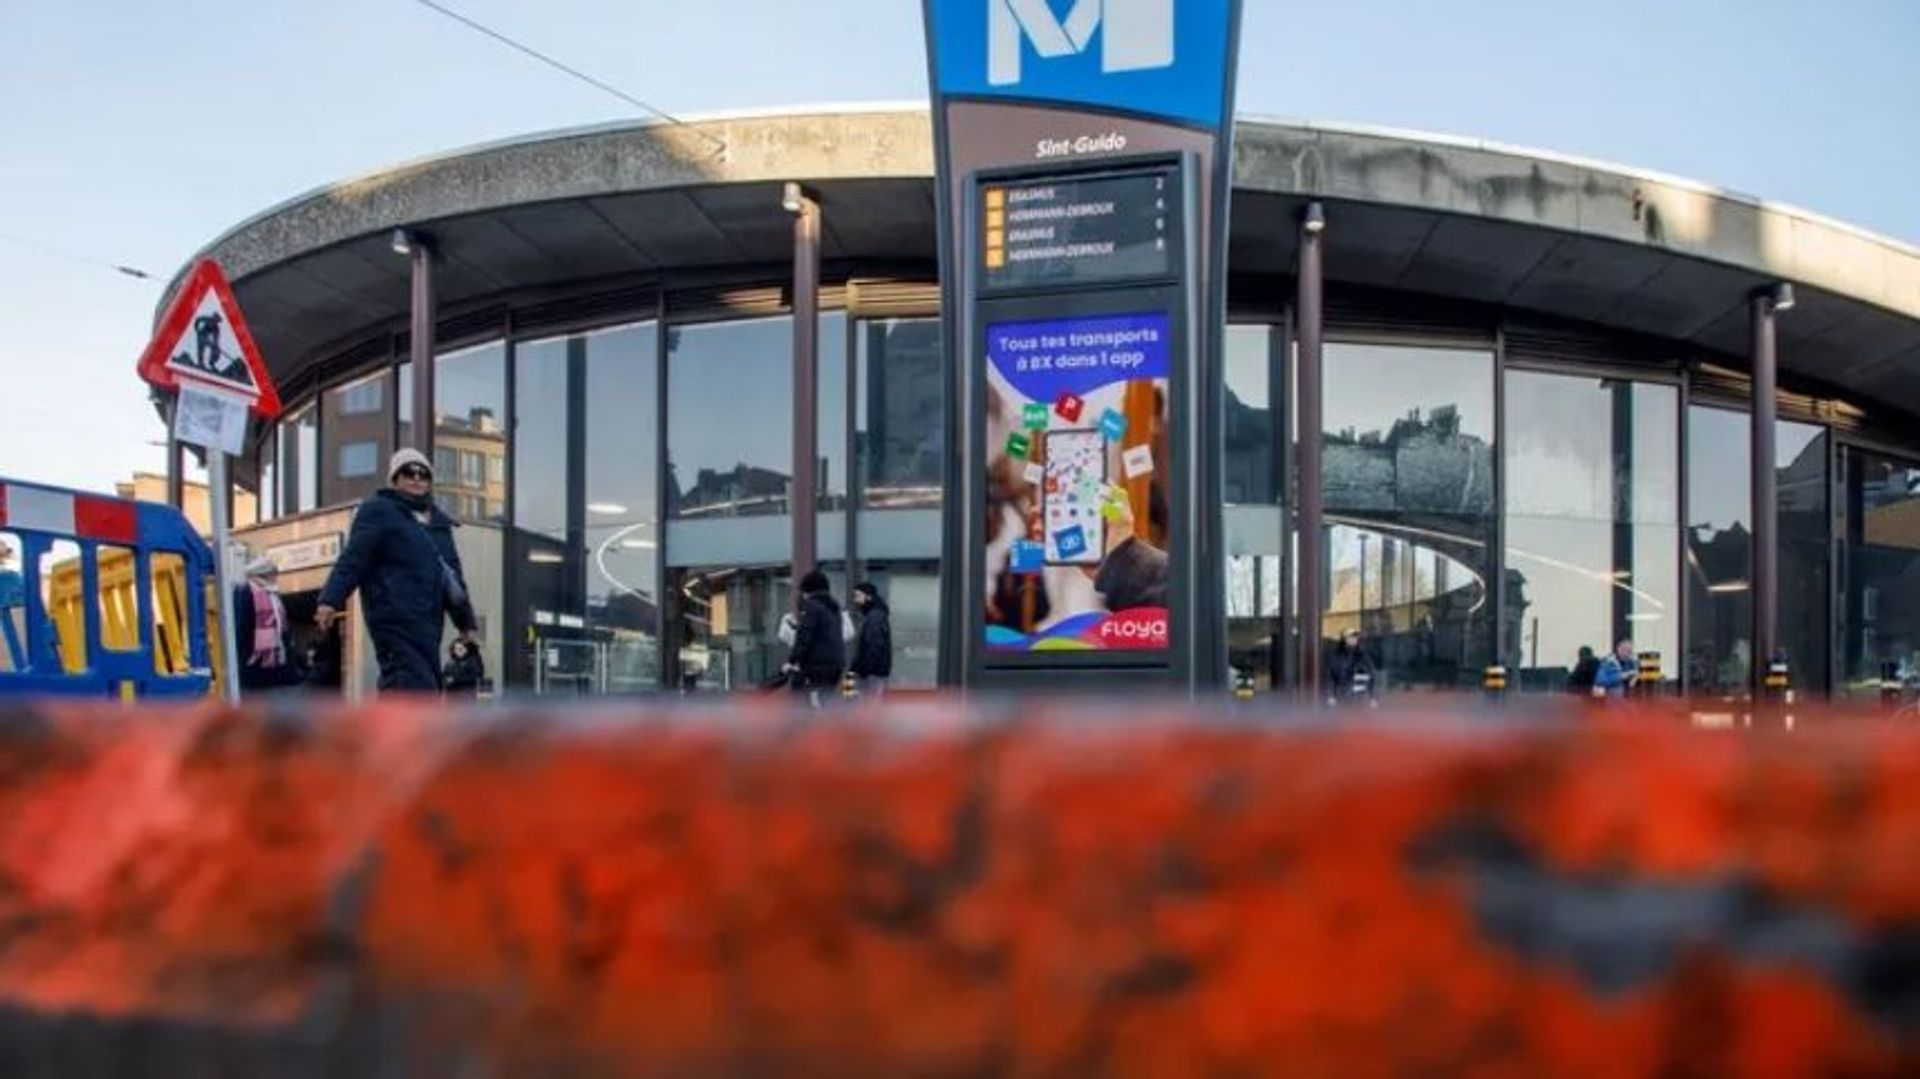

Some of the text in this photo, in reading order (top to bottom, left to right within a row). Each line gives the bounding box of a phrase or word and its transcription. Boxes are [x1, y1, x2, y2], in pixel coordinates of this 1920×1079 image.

[988, 0, 1174, 85] M
[1036, 133, 1127, 158] Sint-Guido
[1000, 329, 1159, 351] Tous tes transports
[1030, 355, 1053, 369] BX
[1056, 353, 1097, 368] dans
[1110, 351, 1144, 367] app
